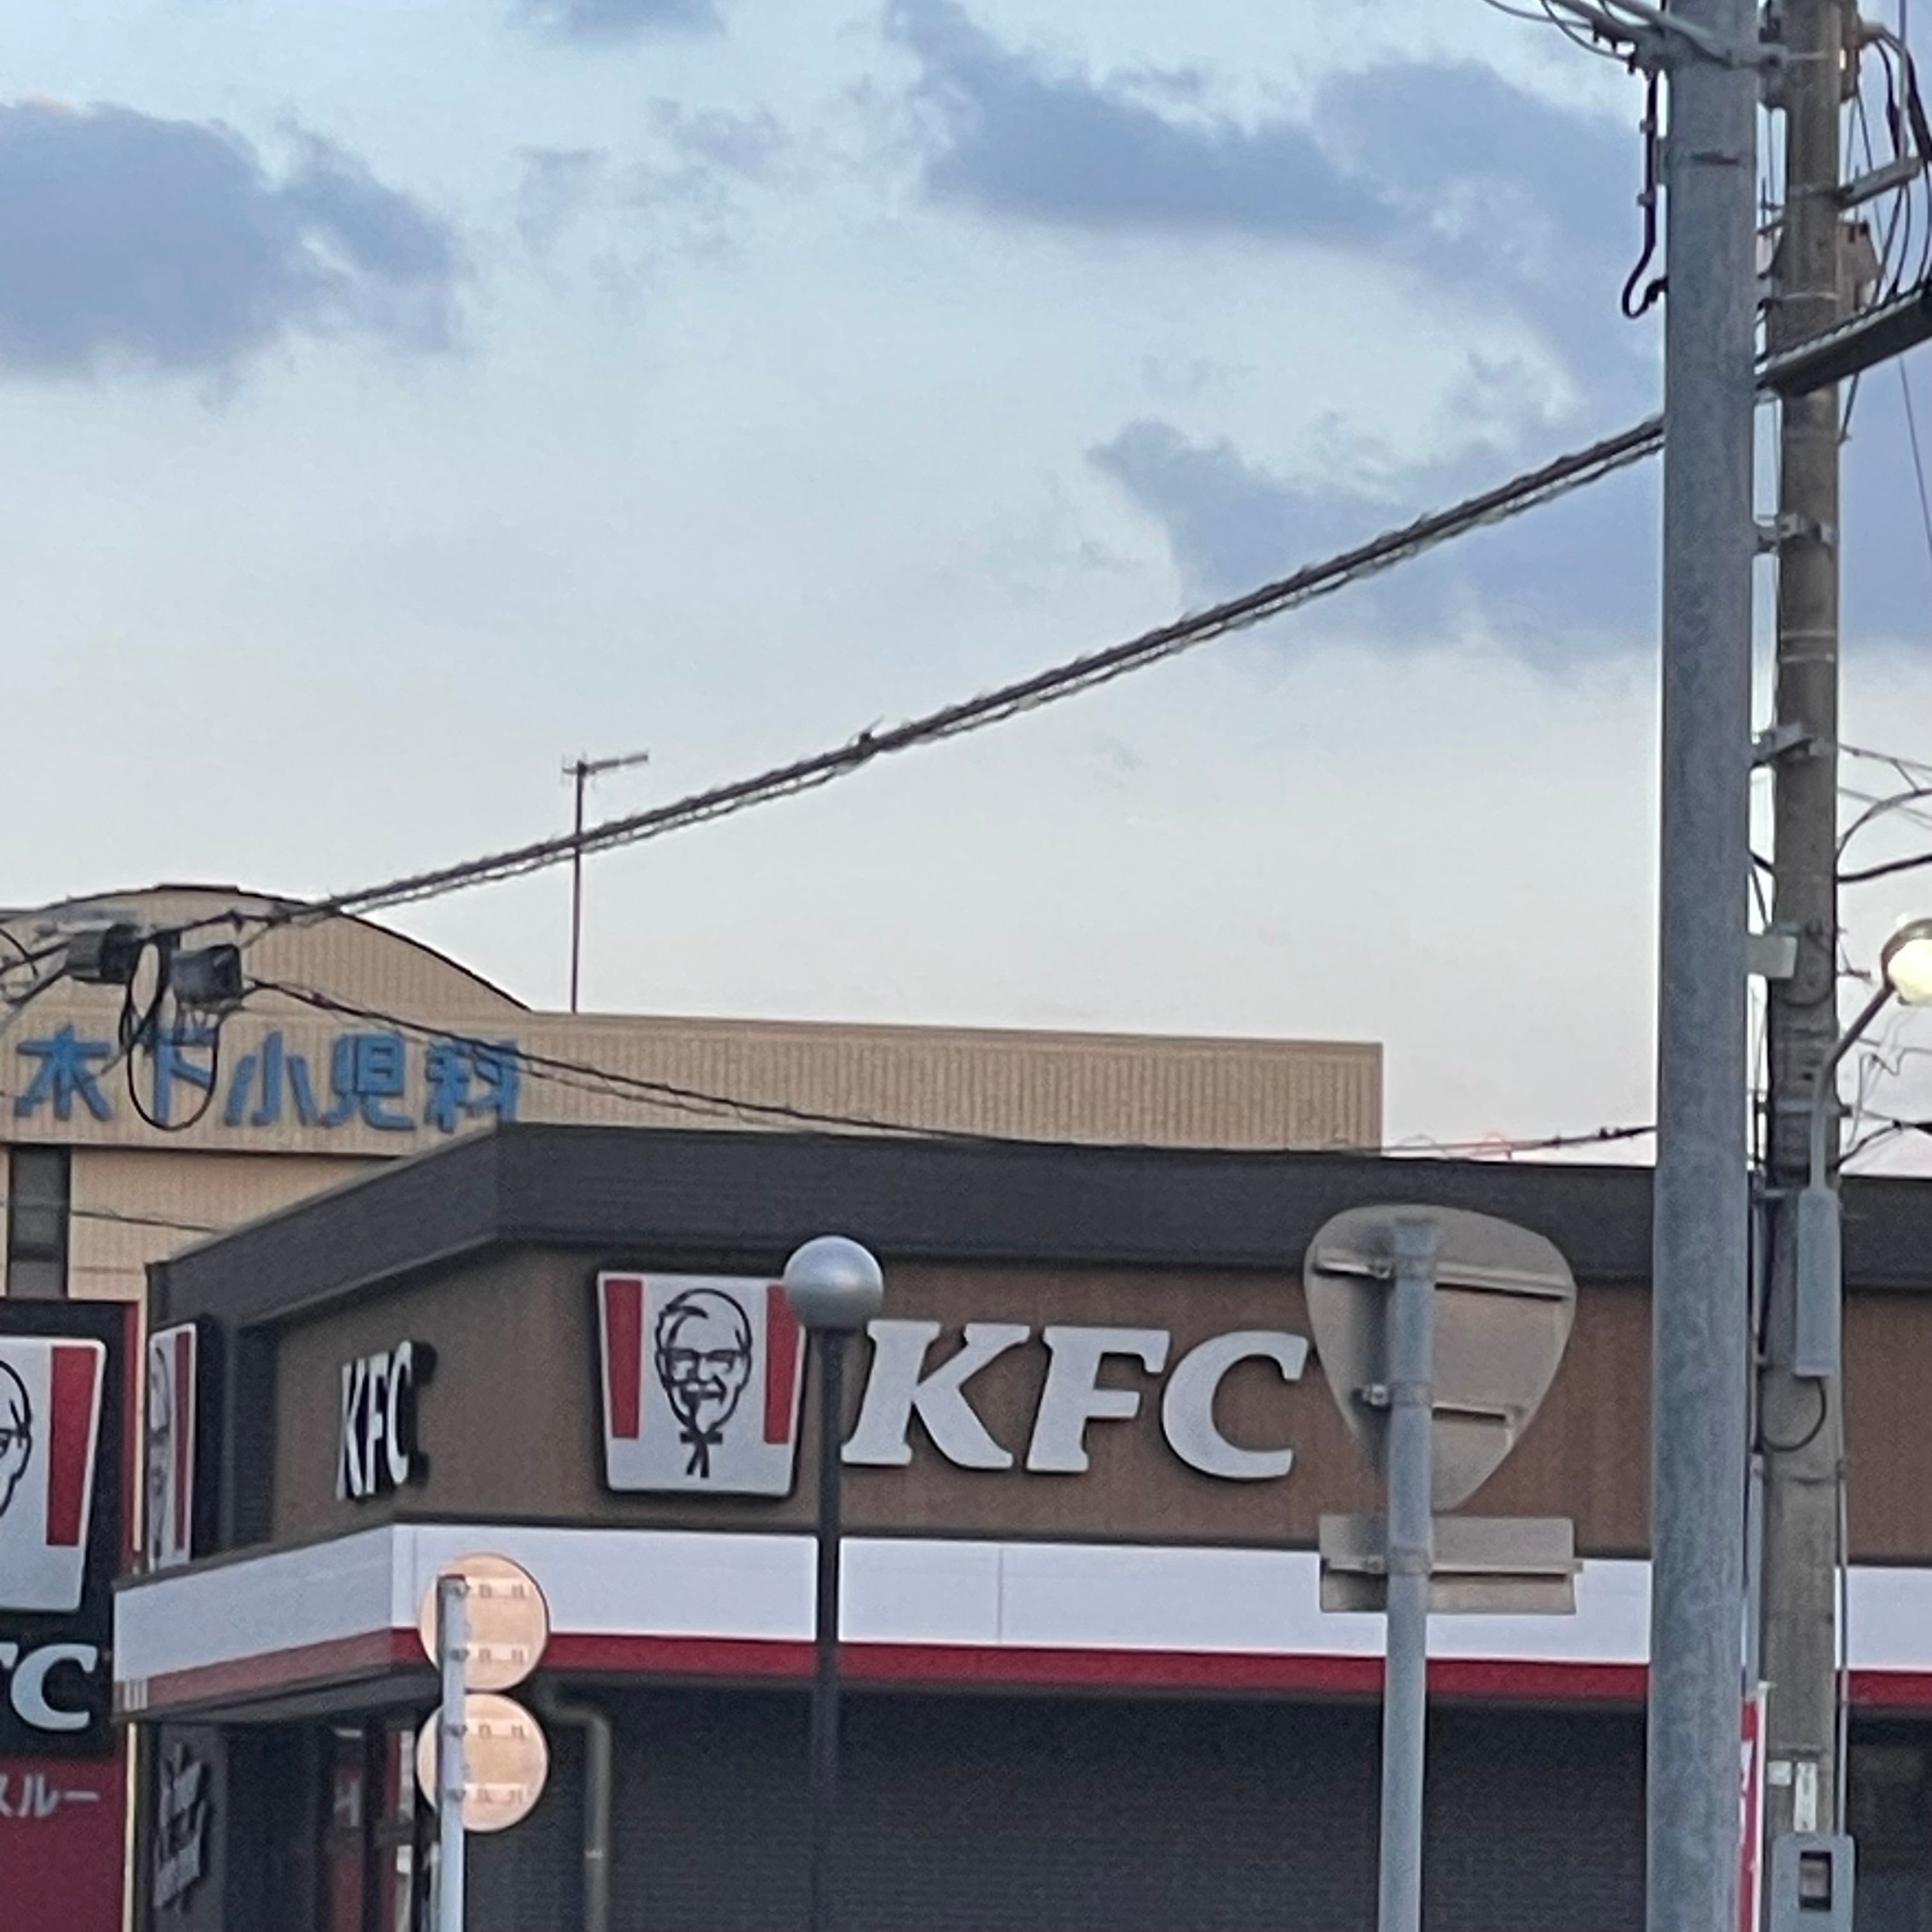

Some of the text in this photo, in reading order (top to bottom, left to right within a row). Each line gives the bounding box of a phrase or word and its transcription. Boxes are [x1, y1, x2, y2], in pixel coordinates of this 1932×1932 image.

[14, 1023, 520, 1133] 木下小児科
[336, 1340, 412, 1499] KFC
[841, 1320, 1308, 1478] KFC
